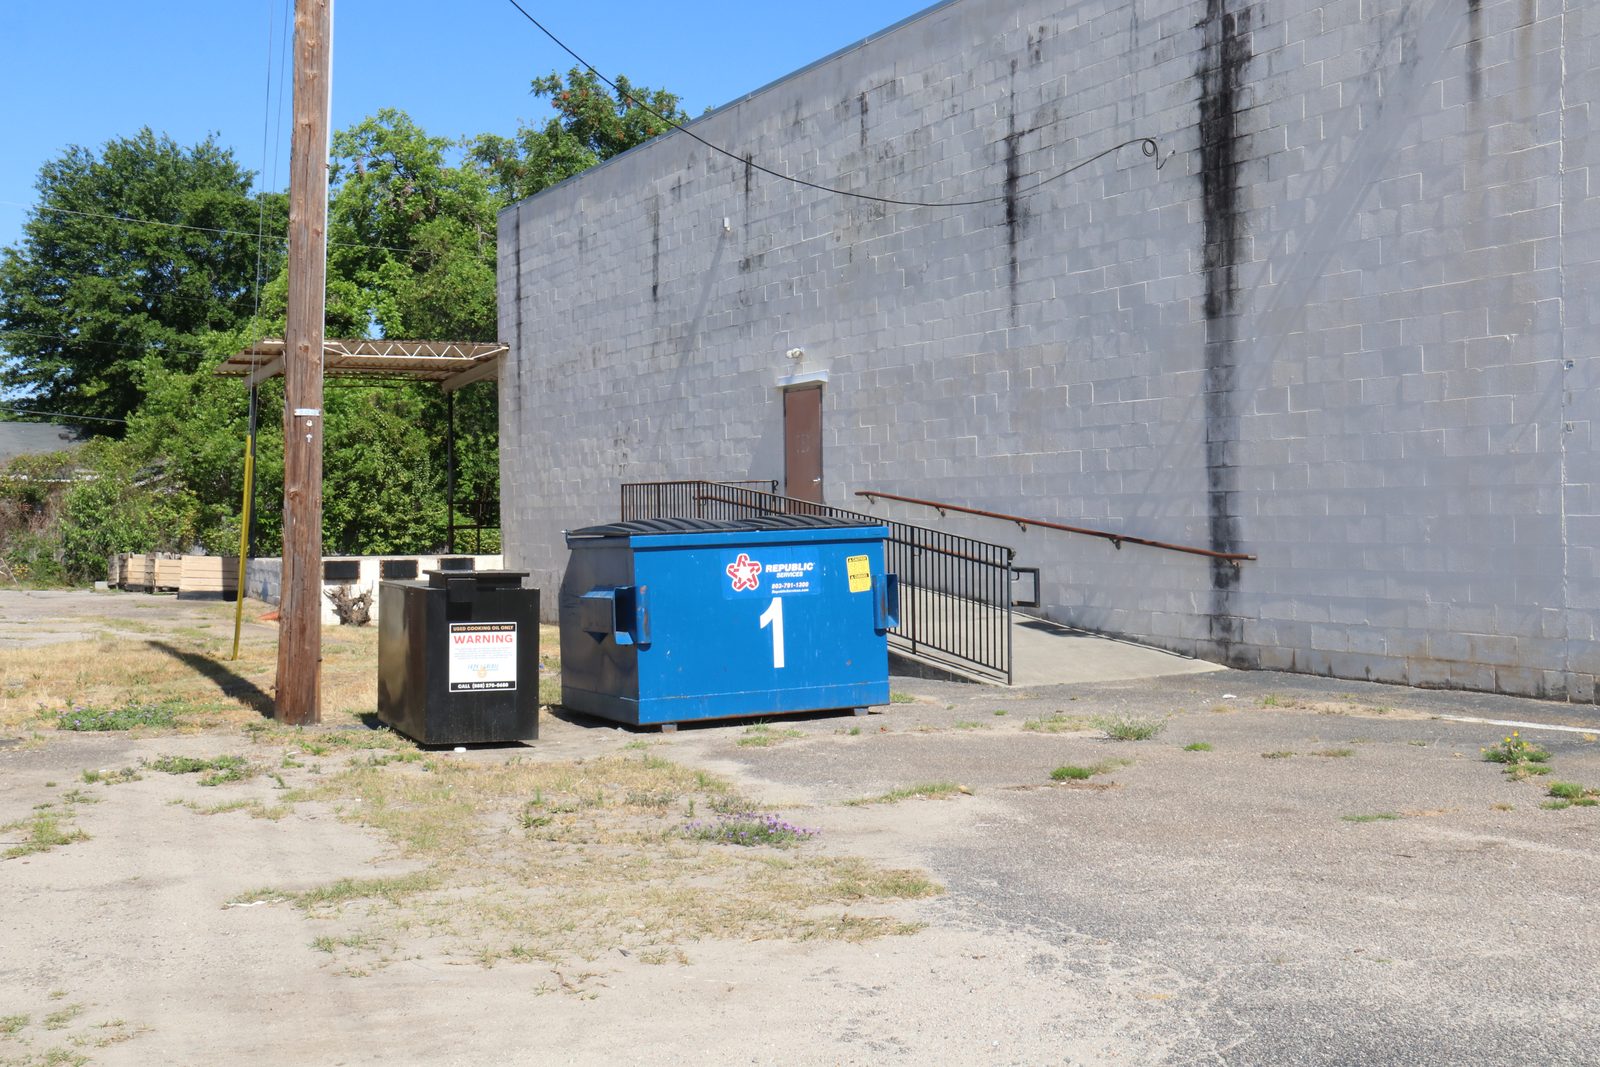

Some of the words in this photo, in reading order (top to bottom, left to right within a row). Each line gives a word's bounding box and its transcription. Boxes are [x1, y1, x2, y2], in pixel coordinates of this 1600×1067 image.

[766, 562, 814, 572] REPUBLIC
[760, 597, 785, 668] 1
[454, 635, 513, 644] WARNING
